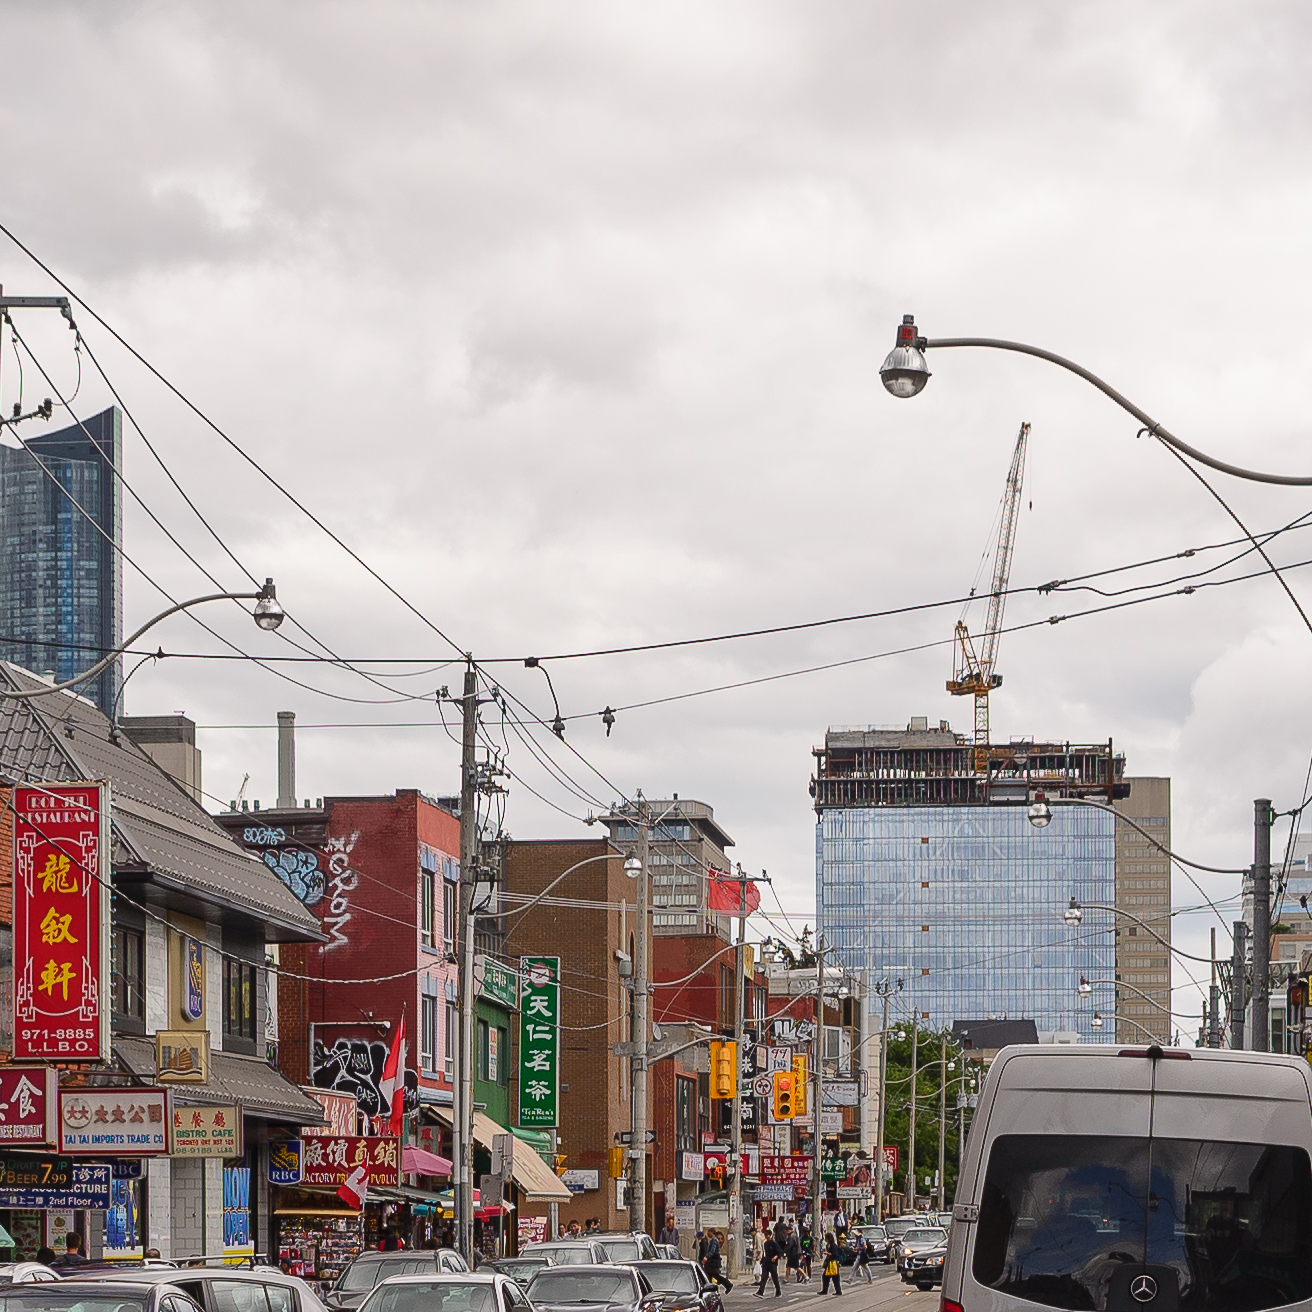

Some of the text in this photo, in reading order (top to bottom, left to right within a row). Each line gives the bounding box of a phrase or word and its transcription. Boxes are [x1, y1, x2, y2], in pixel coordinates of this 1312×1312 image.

[21, 1029, 95, 1040] 971-8885
[28, 1041, 93, 1052] L.L.B.O.
[524, 995, 554, 1101] 天仁茗茶
[92, 1133, 125, 1145] IMPORTS
[127, 1133, 151, 1145] TRADE
[176, 1129, 234, 1138] BISTRO CAFE
[272, 1170, 299, 1182] RBC
[48, 1196, 93, 1207] 2nd Floor
